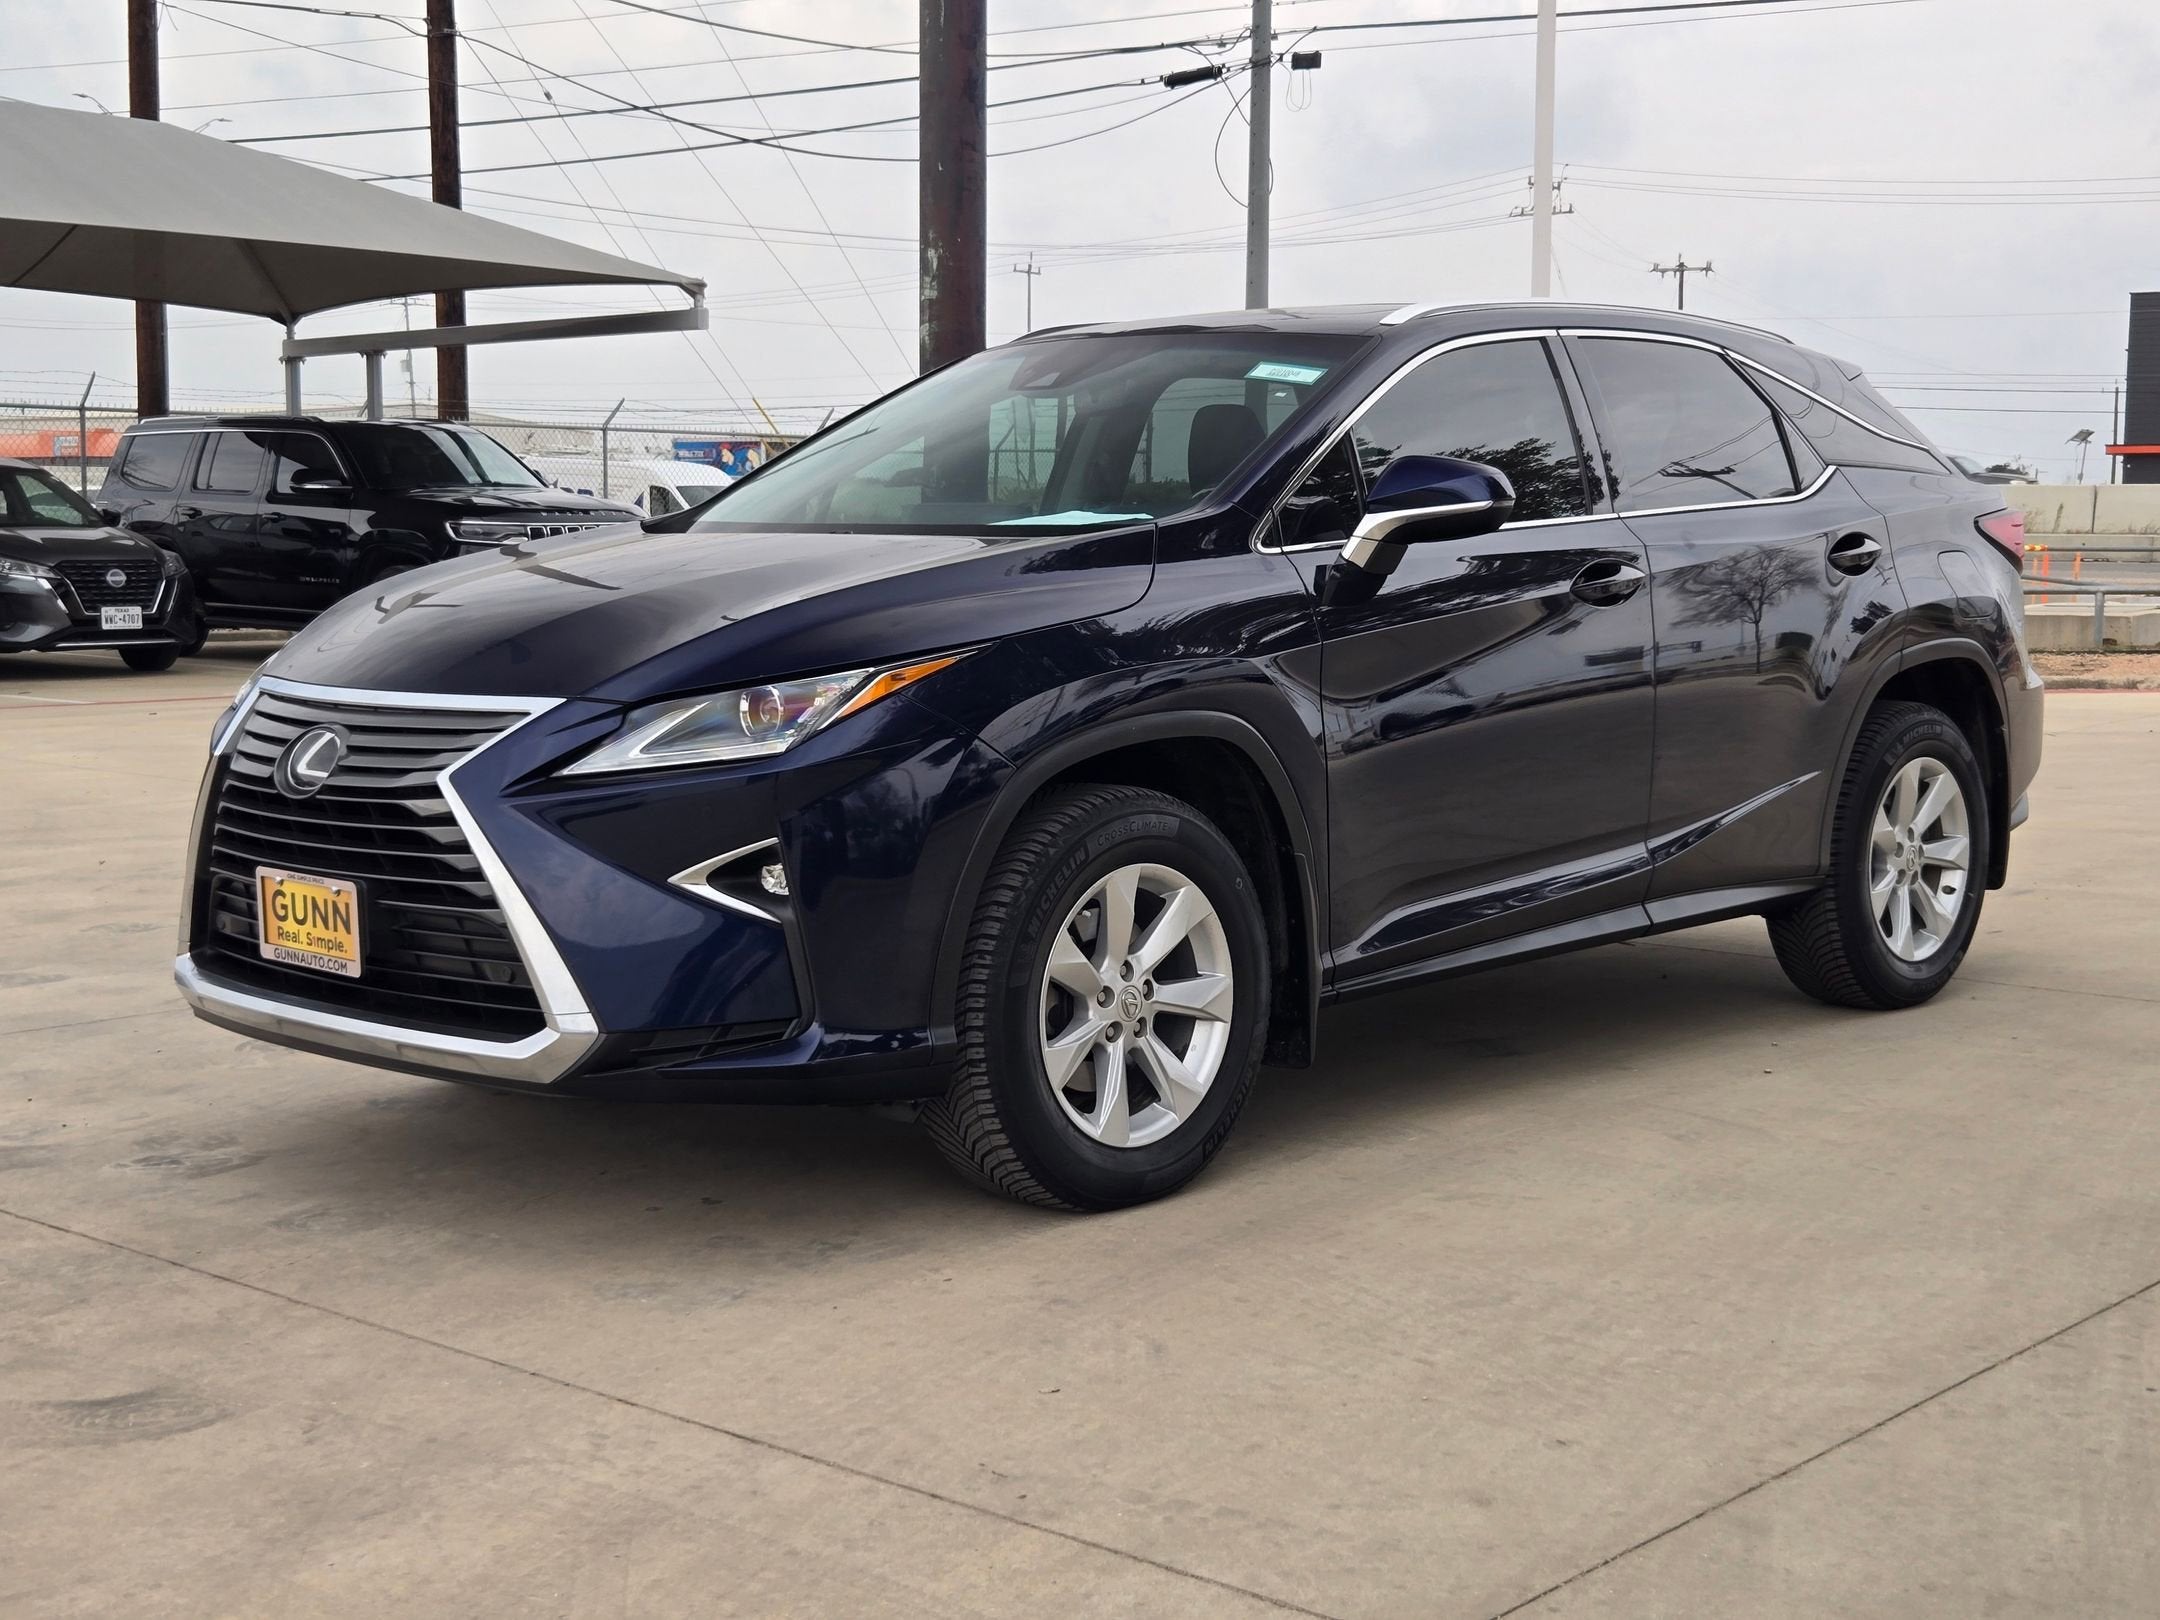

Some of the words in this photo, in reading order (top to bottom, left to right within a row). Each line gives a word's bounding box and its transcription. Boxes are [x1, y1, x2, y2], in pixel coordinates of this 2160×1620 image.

[1028, 846, 1088, 938] MICHELIN
[271, 889, 351, 935] GUNN
[277, 926, 303, 945] Real.
[274, 947, 348, 973] GUNNAUTO.COM
